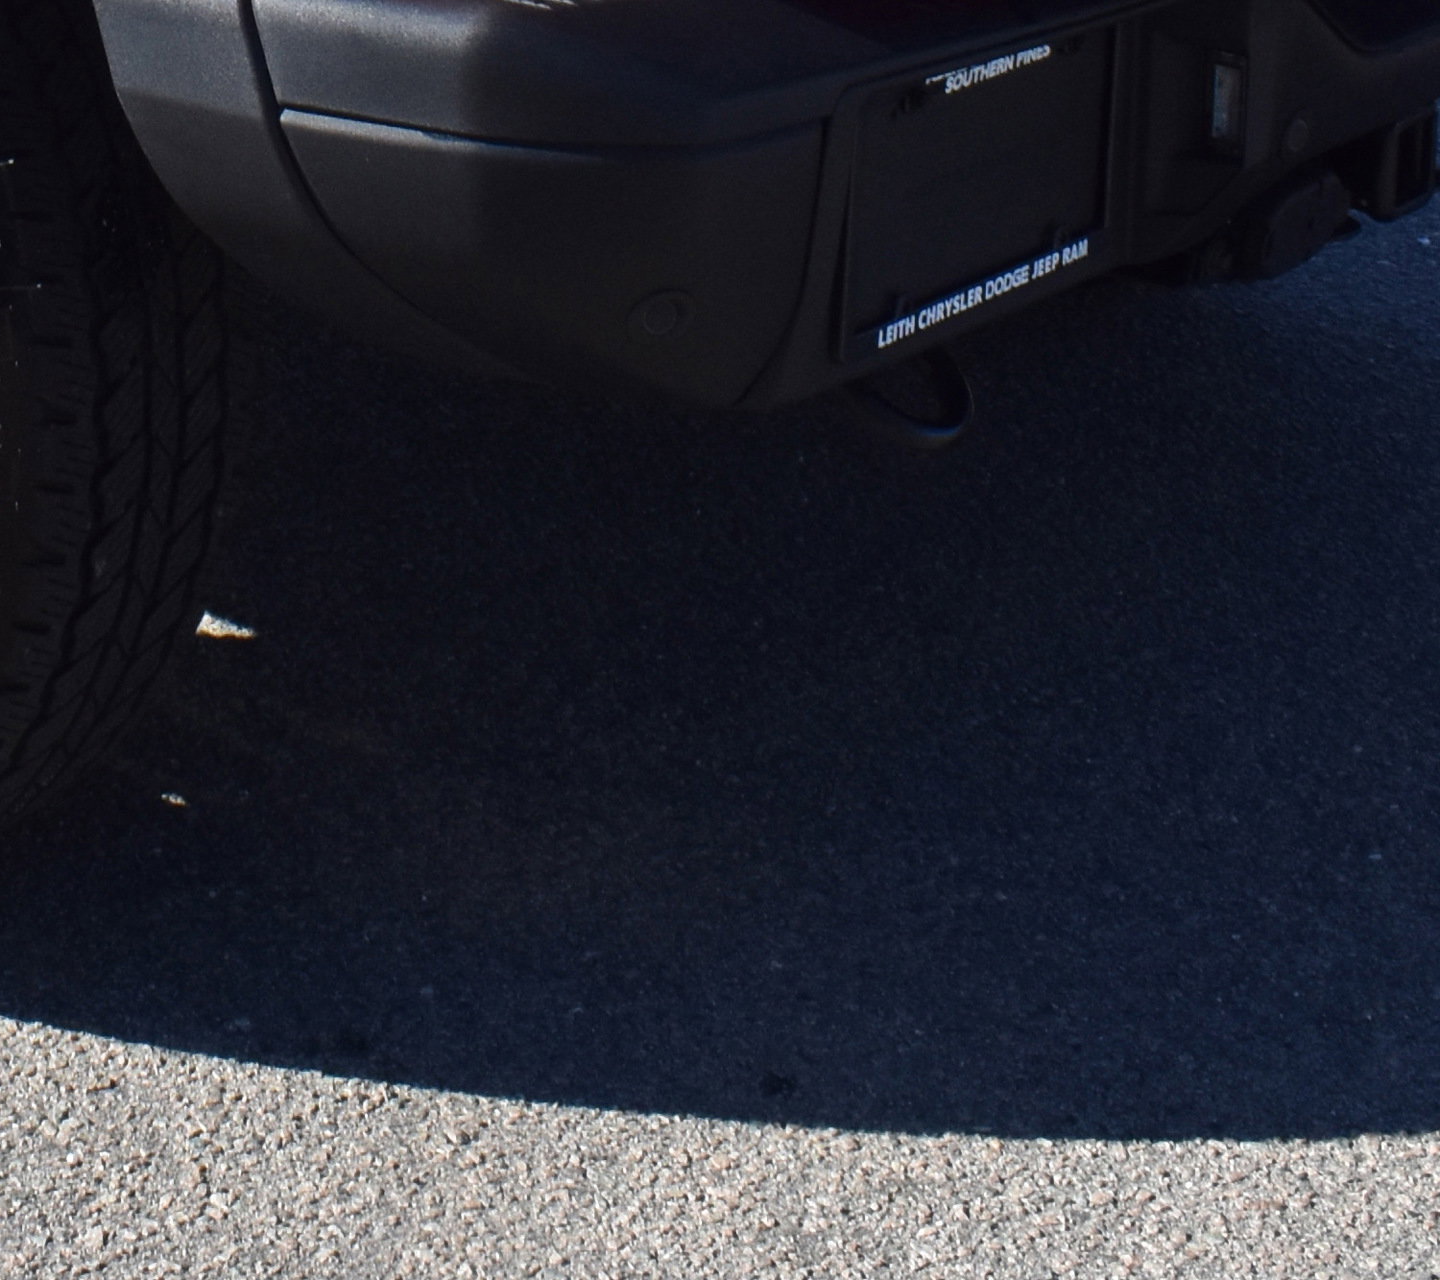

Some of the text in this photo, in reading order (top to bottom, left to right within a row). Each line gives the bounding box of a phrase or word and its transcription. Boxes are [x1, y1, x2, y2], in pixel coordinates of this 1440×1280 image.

[944, 53, 1015, 95] SOUTHERN
[877, 237, 1089, 350] LEITH CHRYSLER DODGE JEEP RAM
